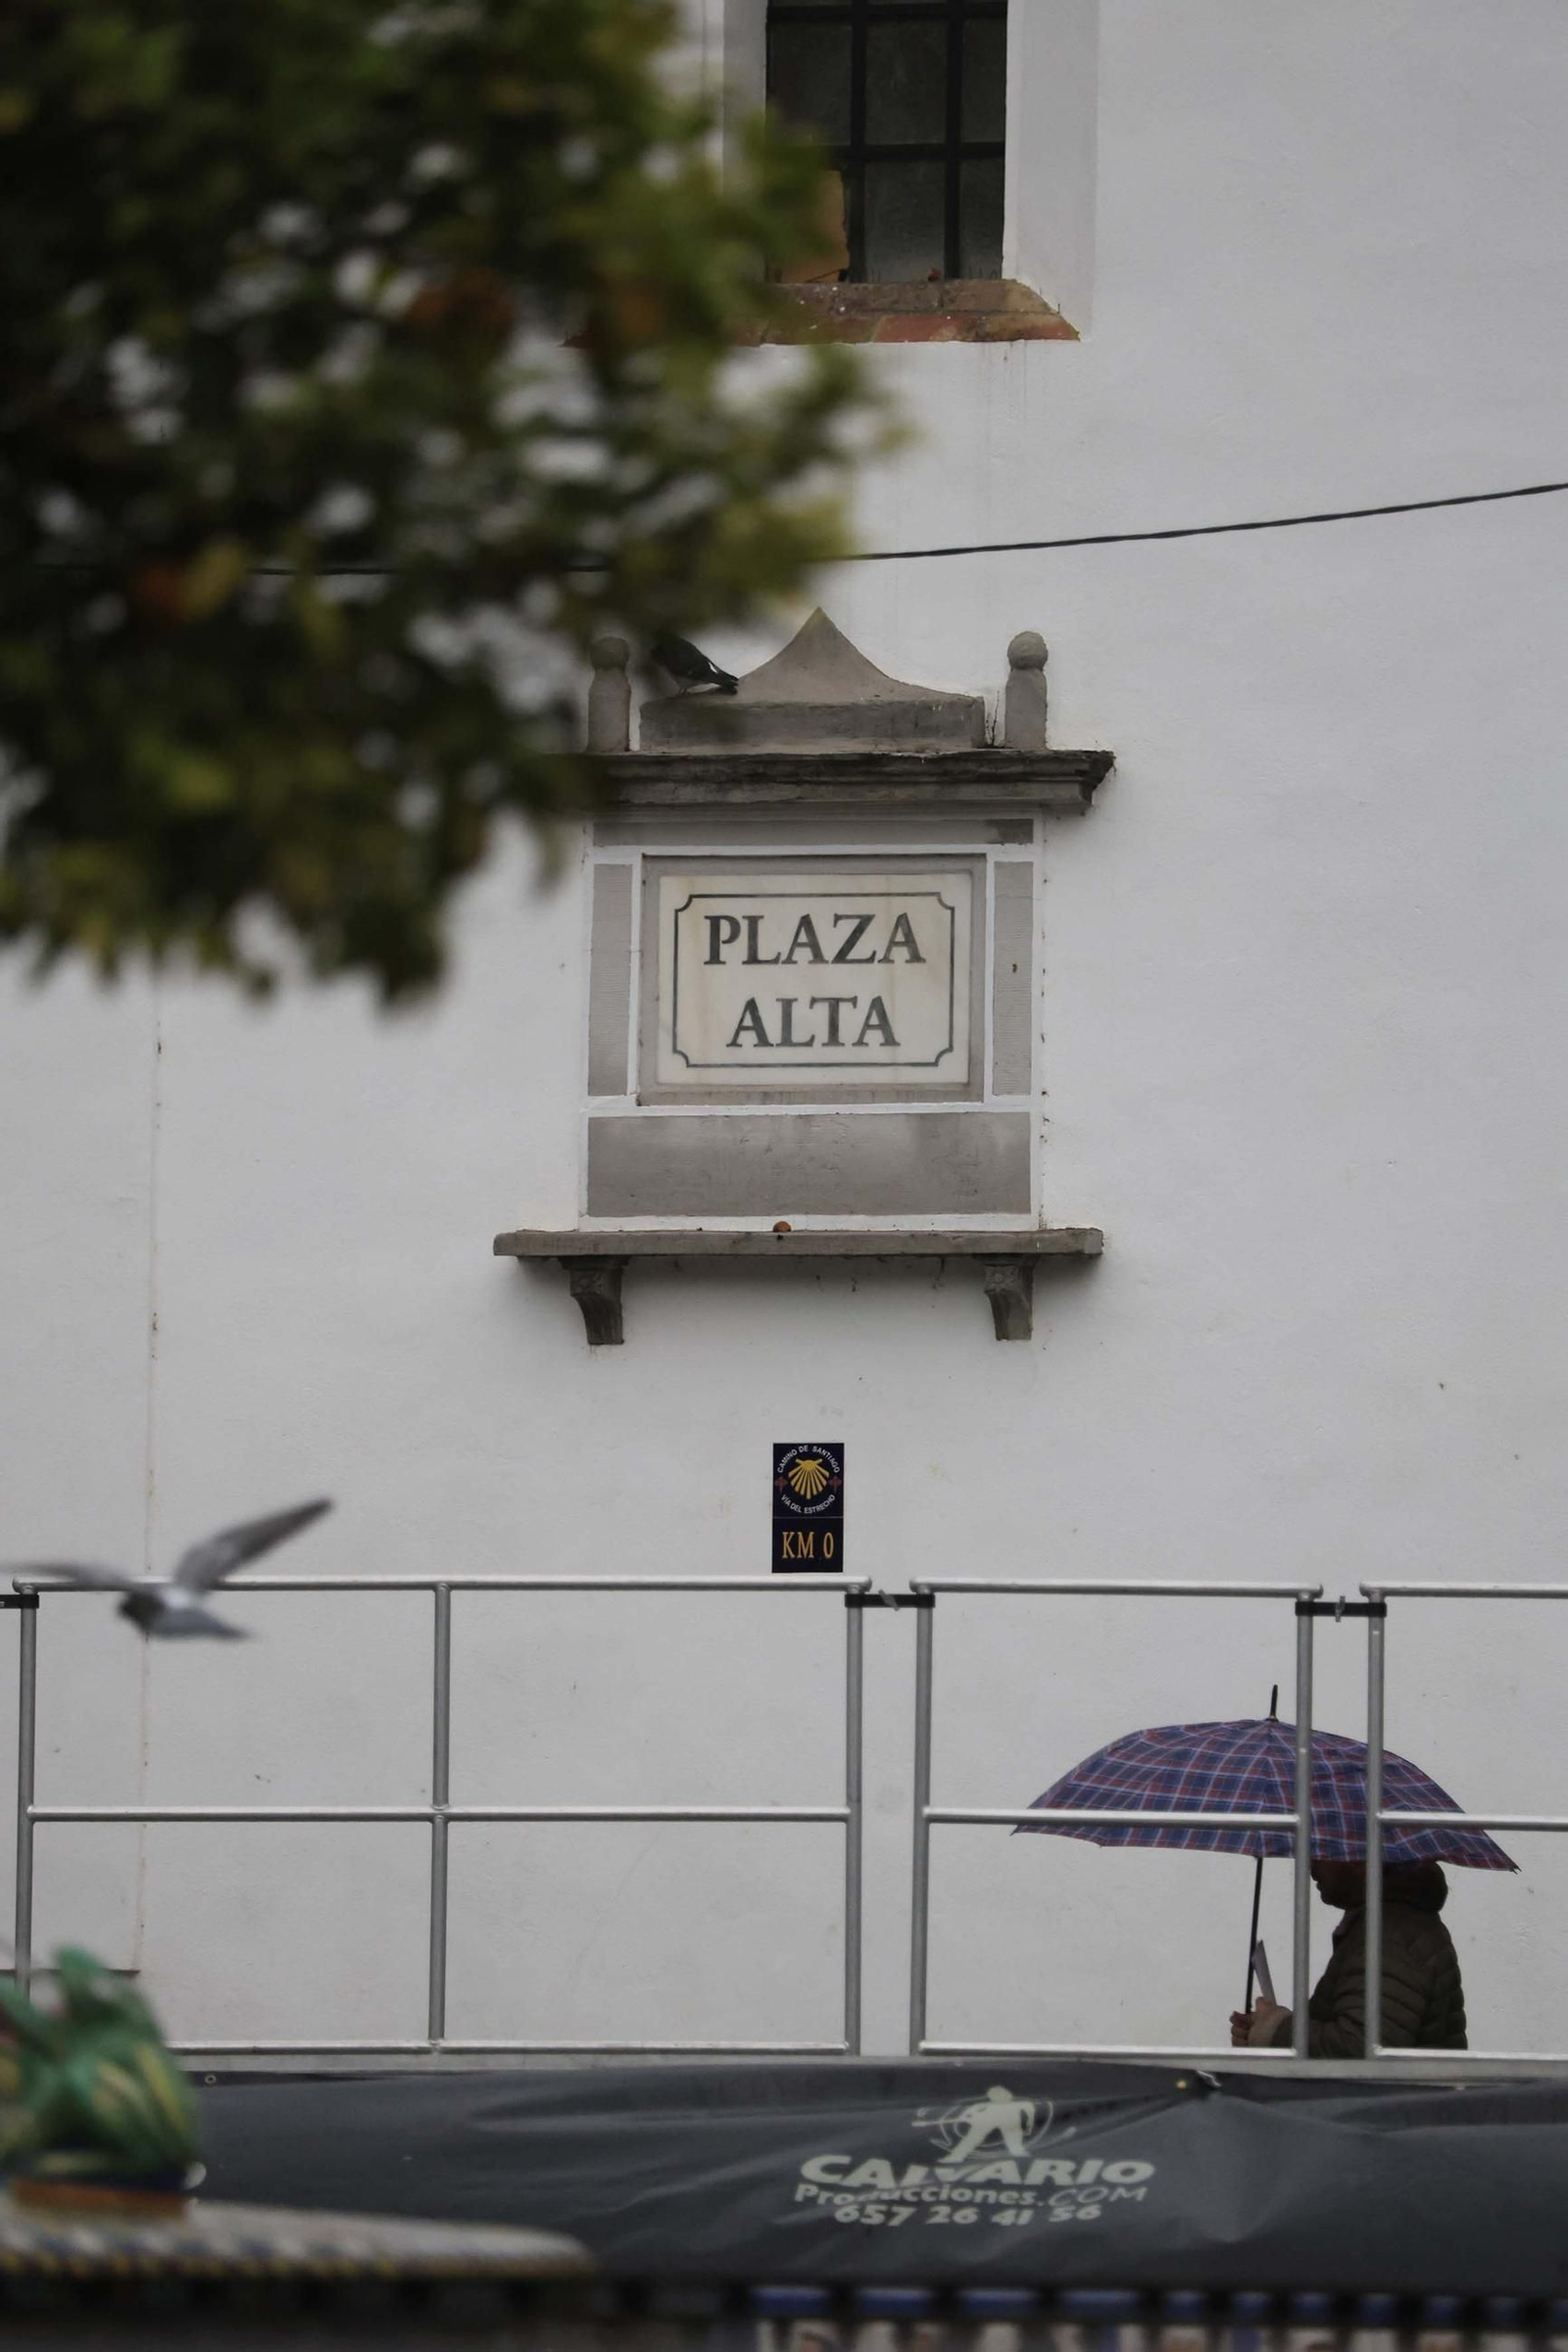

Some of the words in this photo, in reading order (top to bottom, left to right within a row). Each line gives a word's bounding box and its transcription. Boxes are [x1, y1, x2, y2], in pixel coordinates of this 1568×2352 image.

[704, 912, 926, 964] PLAZA
[726, 996, 901, 1047] ALTA
[777, 1448, 798, 1473] CAMINO
[812, 1446, 840, 1473] SANTIAGO
[790, 1502, 802, 1513] DEL
[804, 1494, 835, 1514] ESTRECHO
[782, 1531, 814, 1558] KM
[823, 1532, 834, 1558] 0
[834, 2205, 917, 2227] 657
[925, 2205, 978, 2225] 26
[991, 2209, 1034, 2227] 41
[1049, 2204, 1102, 2223] 56
